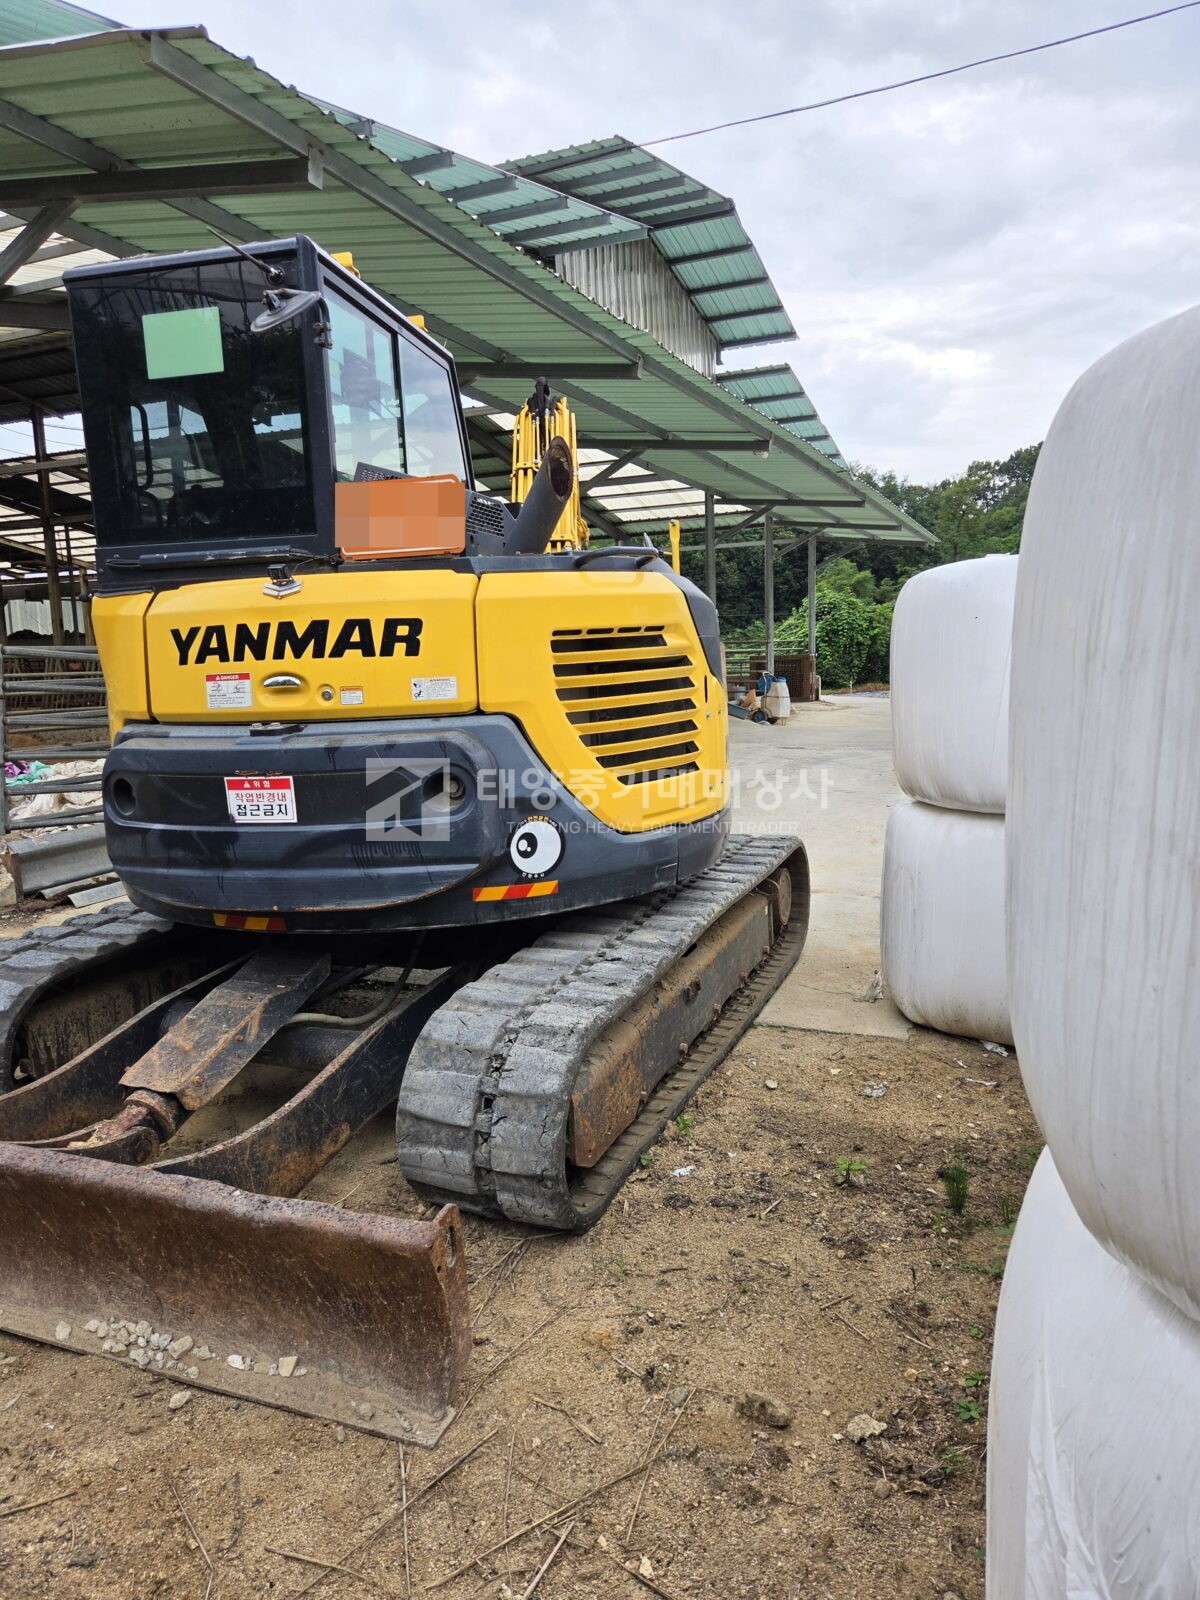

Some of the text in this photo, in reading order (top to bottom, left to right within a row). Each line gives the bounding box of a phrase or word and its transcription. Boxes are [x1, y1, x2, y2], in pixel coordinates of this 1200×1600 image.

[170, 617, 423, 666] YANMAR
[235, 792, 287, 803] 작업반경내
[236, 803, 288, 817] 접근금지
